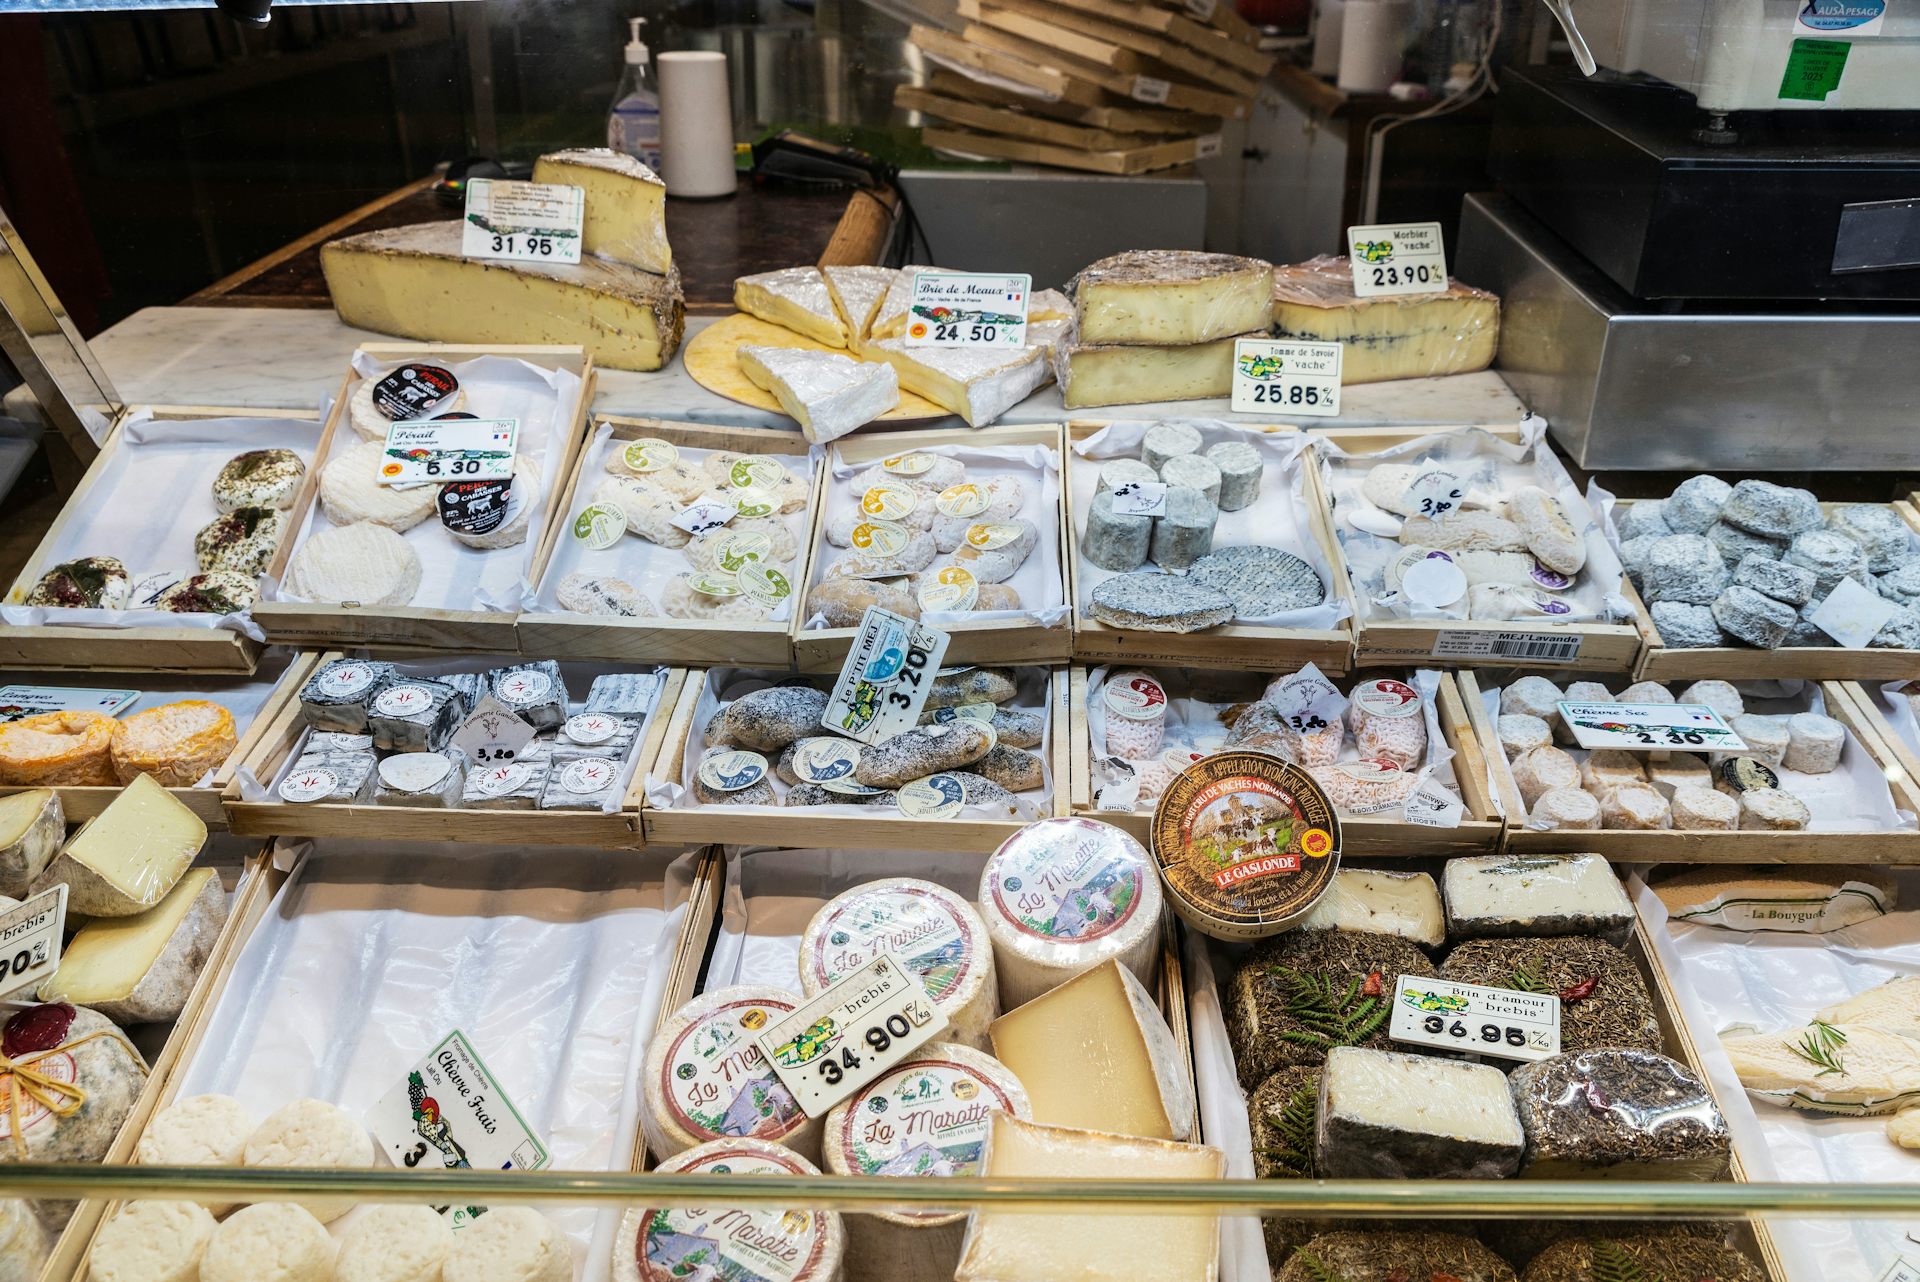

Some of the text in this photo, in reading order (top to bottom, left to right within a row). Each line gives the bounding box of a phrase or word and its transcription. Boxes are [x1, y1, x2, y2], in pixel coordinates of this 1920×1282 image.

[1845, 7, 1880, 16] PESAGE
[1393, 230, 1428, 239] Morbier
[919, 284, 945, 294] Brie
[946, 284, 960, 294] de
[962, 284, 1004, 295] Meaux
[1270, 347, 1335, 357] Tomme de Savoie
[395, 430, 436, 440] Pérail
[840, 625, 878, 704] Le P'TIT MEJ
[1572, 708, 1621, 716] Chèvre
[1212, 760, 1264, 778] APPELLATION
[1264, 764, 1303, 794] D'ORIGINE
[1184, 779, 1293, 828] AU LAIT CRU DE VACHES NORMANDES
[1217, 856, 1296, 886] LE GASLONDE
[1253, 894, 1278, 907] louche
[1279, 889, 1286, 900] et
[1296, 869, 1313, 886] main
[1018, 892, 1046, 914] La
[1751, 909, 1765, 919] La
[833, 950, 863, 971] La
[1451, 987, 1547, 1008] Brin d'amour
[425, 1063, 442, 1086] Lait Cru
[451, 1039, 489, 1091] Fromage de Chèvre
[437, 1050, 497, 1135] Chèvre Frais
[688, 1082, 719, 1108] La
[864, 1101, 990, 1145] La Marotte
